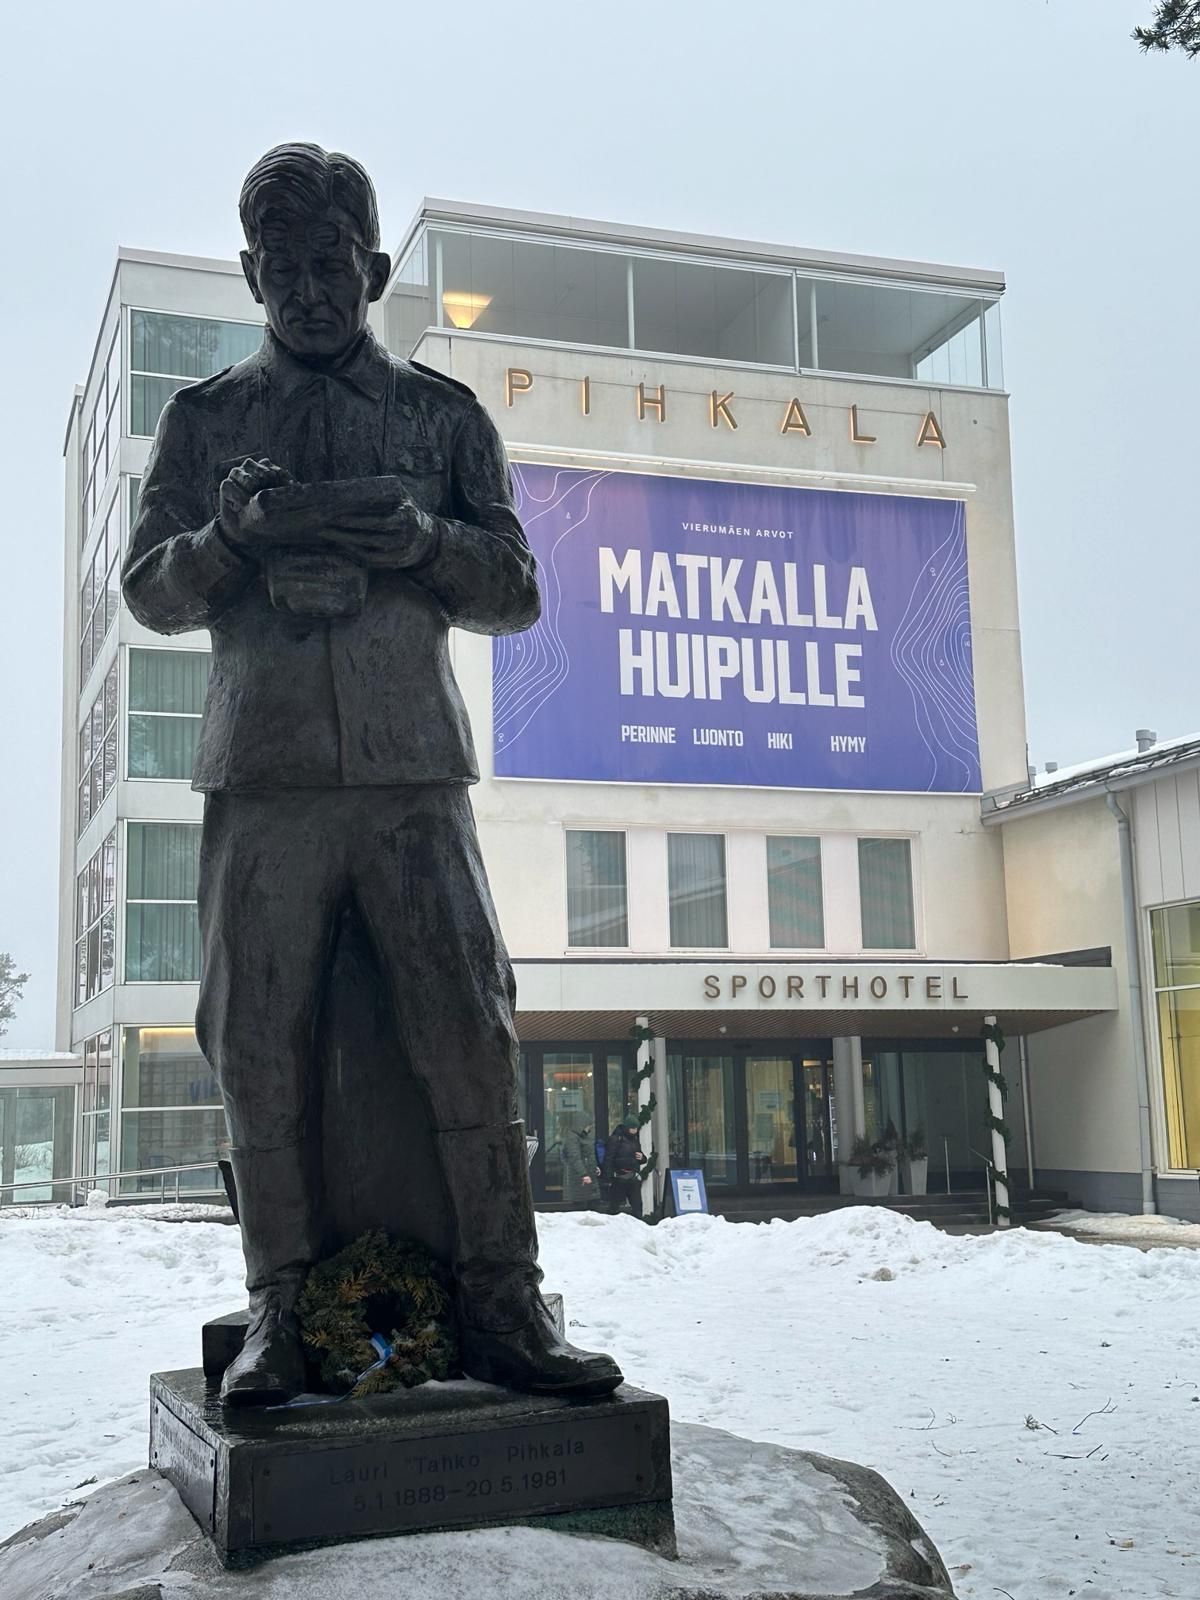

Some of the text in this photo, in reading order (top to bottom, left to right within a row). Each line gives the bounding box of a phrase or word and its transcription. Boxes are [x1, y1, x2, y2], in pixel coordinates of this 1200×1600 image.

[506, 368, 947, 449] PIHKALA
[682, 522, 794, 540] VIERUMÄEN ARVOT
[598, 547, 878, 631] MATKALLA
[619, 629, 865, 708] HUIPULLE
[621, 725, 866, 753] PERINNE LUONTO HIKI HYMY
[704, 975, 969, 999] SPORTHOTEL
[329, 1464, 389, 1486] Lauri
[507, 1438, 585, 1463] Pihkala
